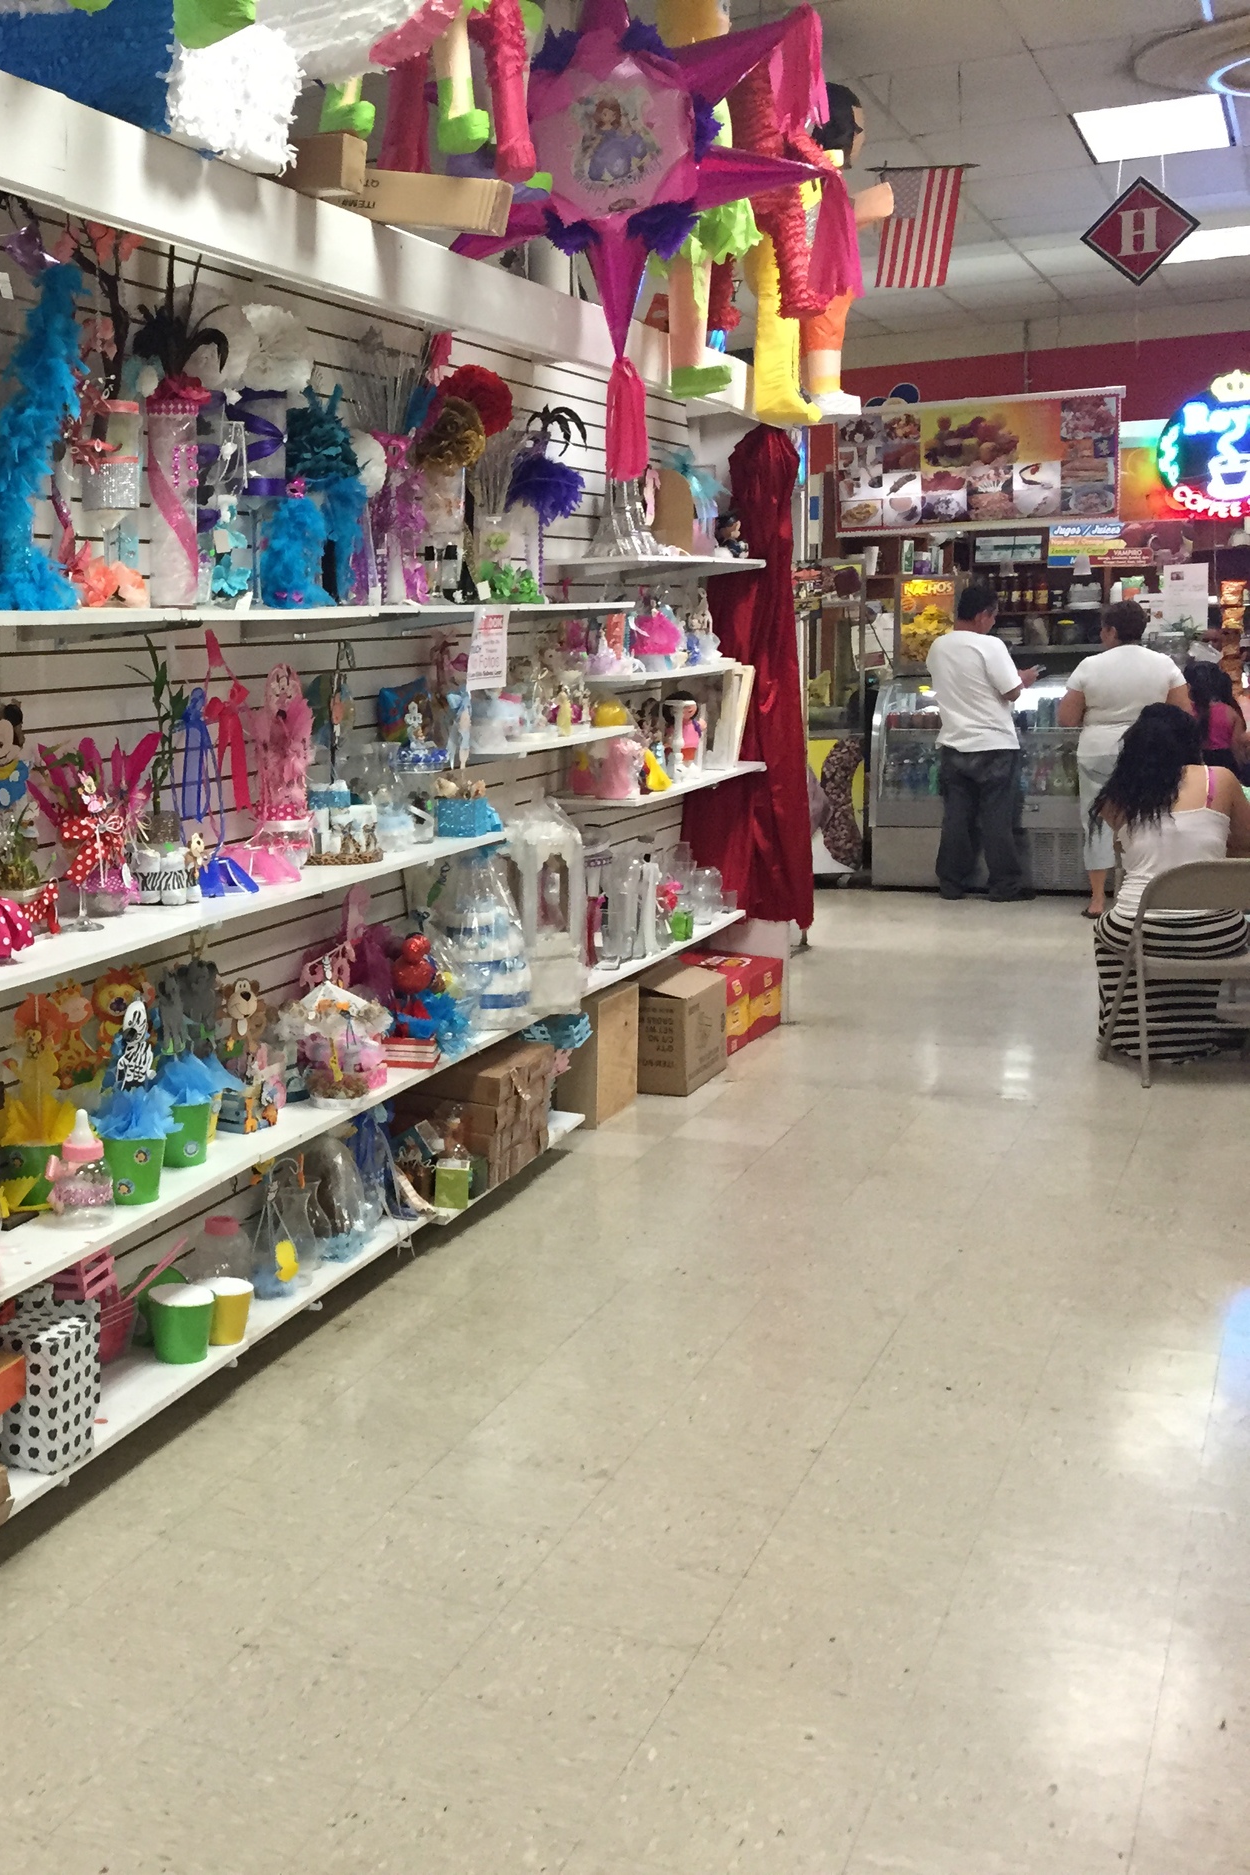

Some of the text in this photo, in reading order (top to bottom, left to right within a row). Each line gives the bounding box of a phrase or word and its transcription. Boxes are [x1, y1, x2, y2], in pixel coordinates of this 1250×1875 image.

[361, 179, 380, 189] QT
[1117, 206, 1162, 257] H
[1173, 485, 1242, 518] COFFEE
[1053, 525, 1081, 537] Jugos
[1091, 525, 1121, 535] Juices
[903, 581, 953, 595] NACHOS
